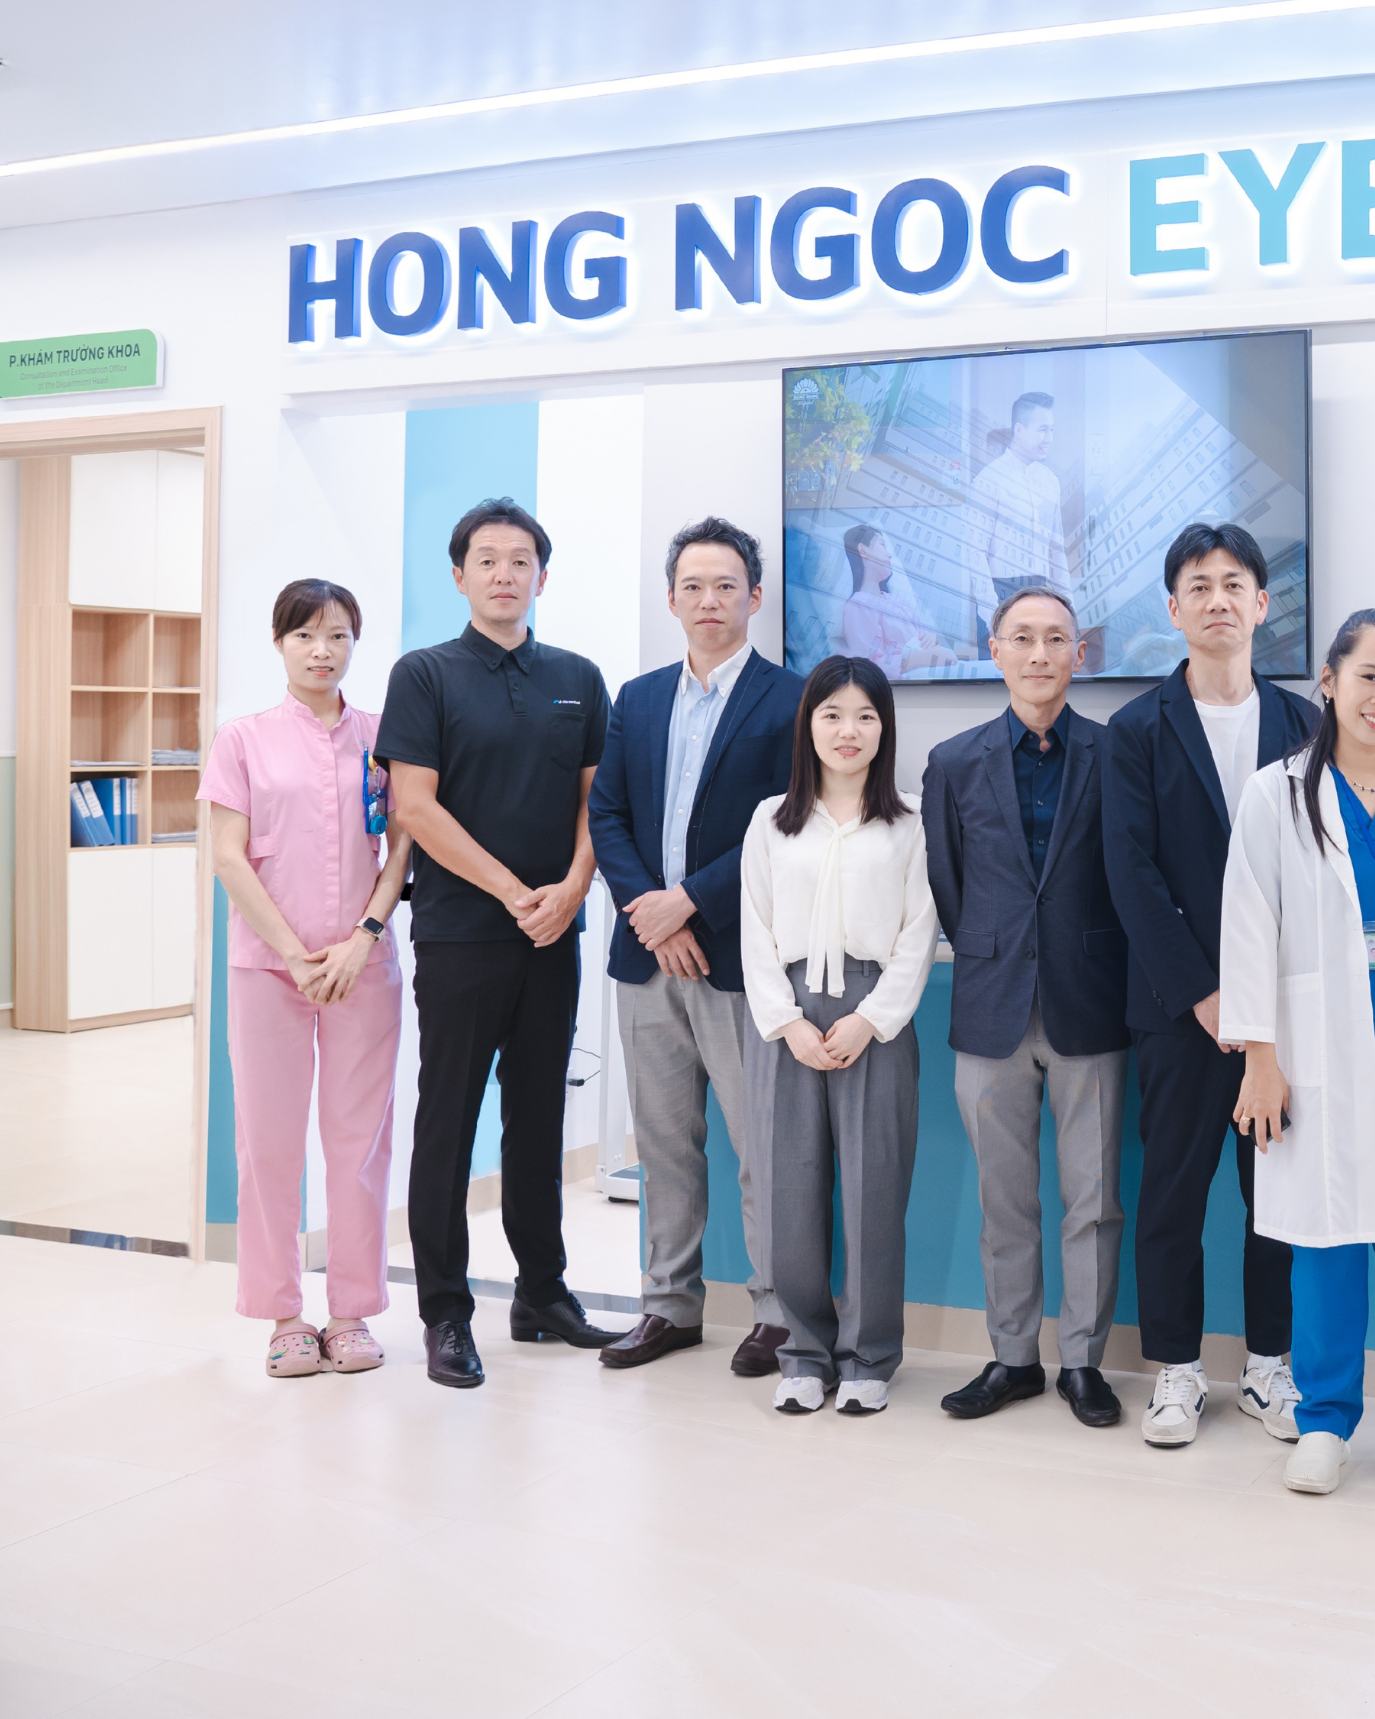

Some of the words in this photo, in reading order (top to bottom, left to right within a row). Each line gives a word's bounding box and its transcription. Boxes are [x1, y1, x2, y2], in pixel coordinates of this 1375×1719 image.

[288, 210, 628, 345] HONG
[674, 165, 1070, 313] NGOC
[9, 349, 53, 368] P.KHÁM
[107, 343, 141, 359] KHOA
[70, 365, 108, 376] Examination
[109, 364, 128, 373] Office
